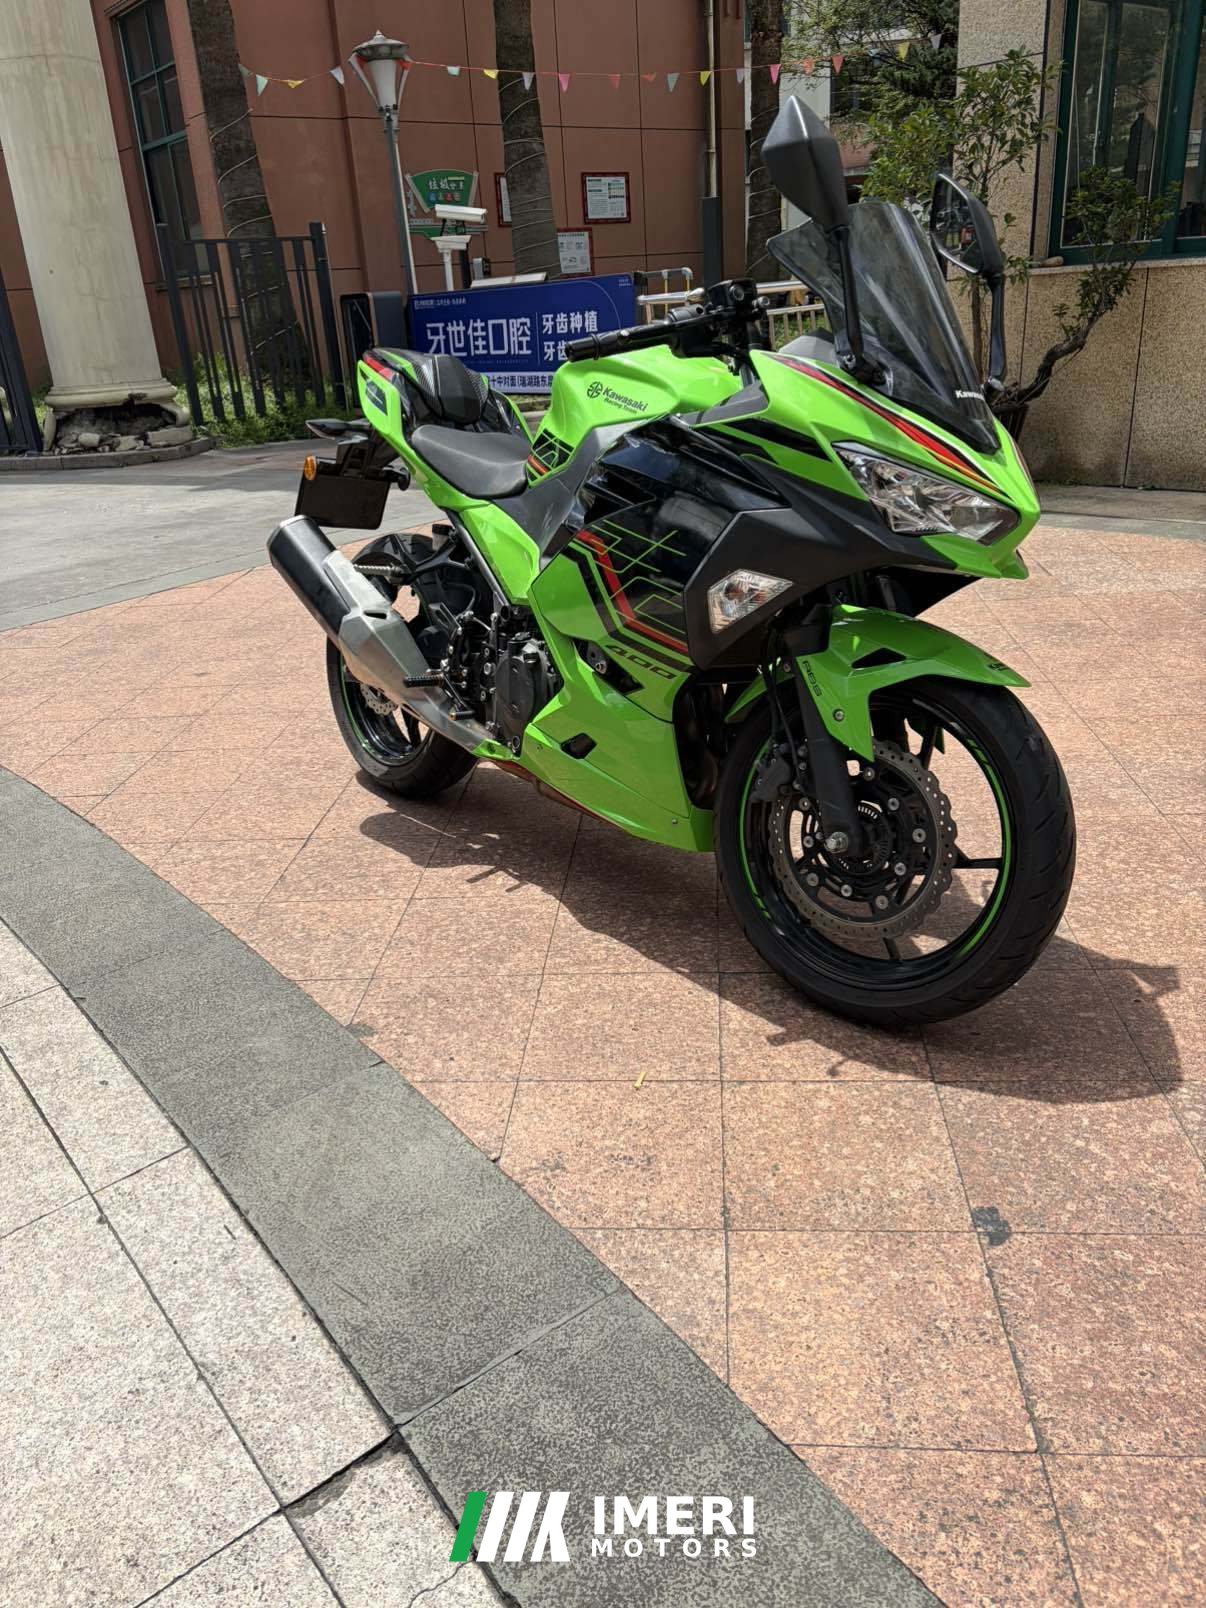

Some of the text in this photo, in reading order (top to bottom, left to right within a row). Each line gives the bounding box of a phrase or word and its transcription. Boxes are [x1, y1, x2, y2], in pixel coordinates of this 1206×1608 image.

[424, 317, 532, 357] 牙世佳口腔
[542, 310, 598, 334] 牙齿种植
[603, 387, 648, 412] Kawasaki
[605, 644, 677, 679] 400
[802, 660, 822, 696] ABS
